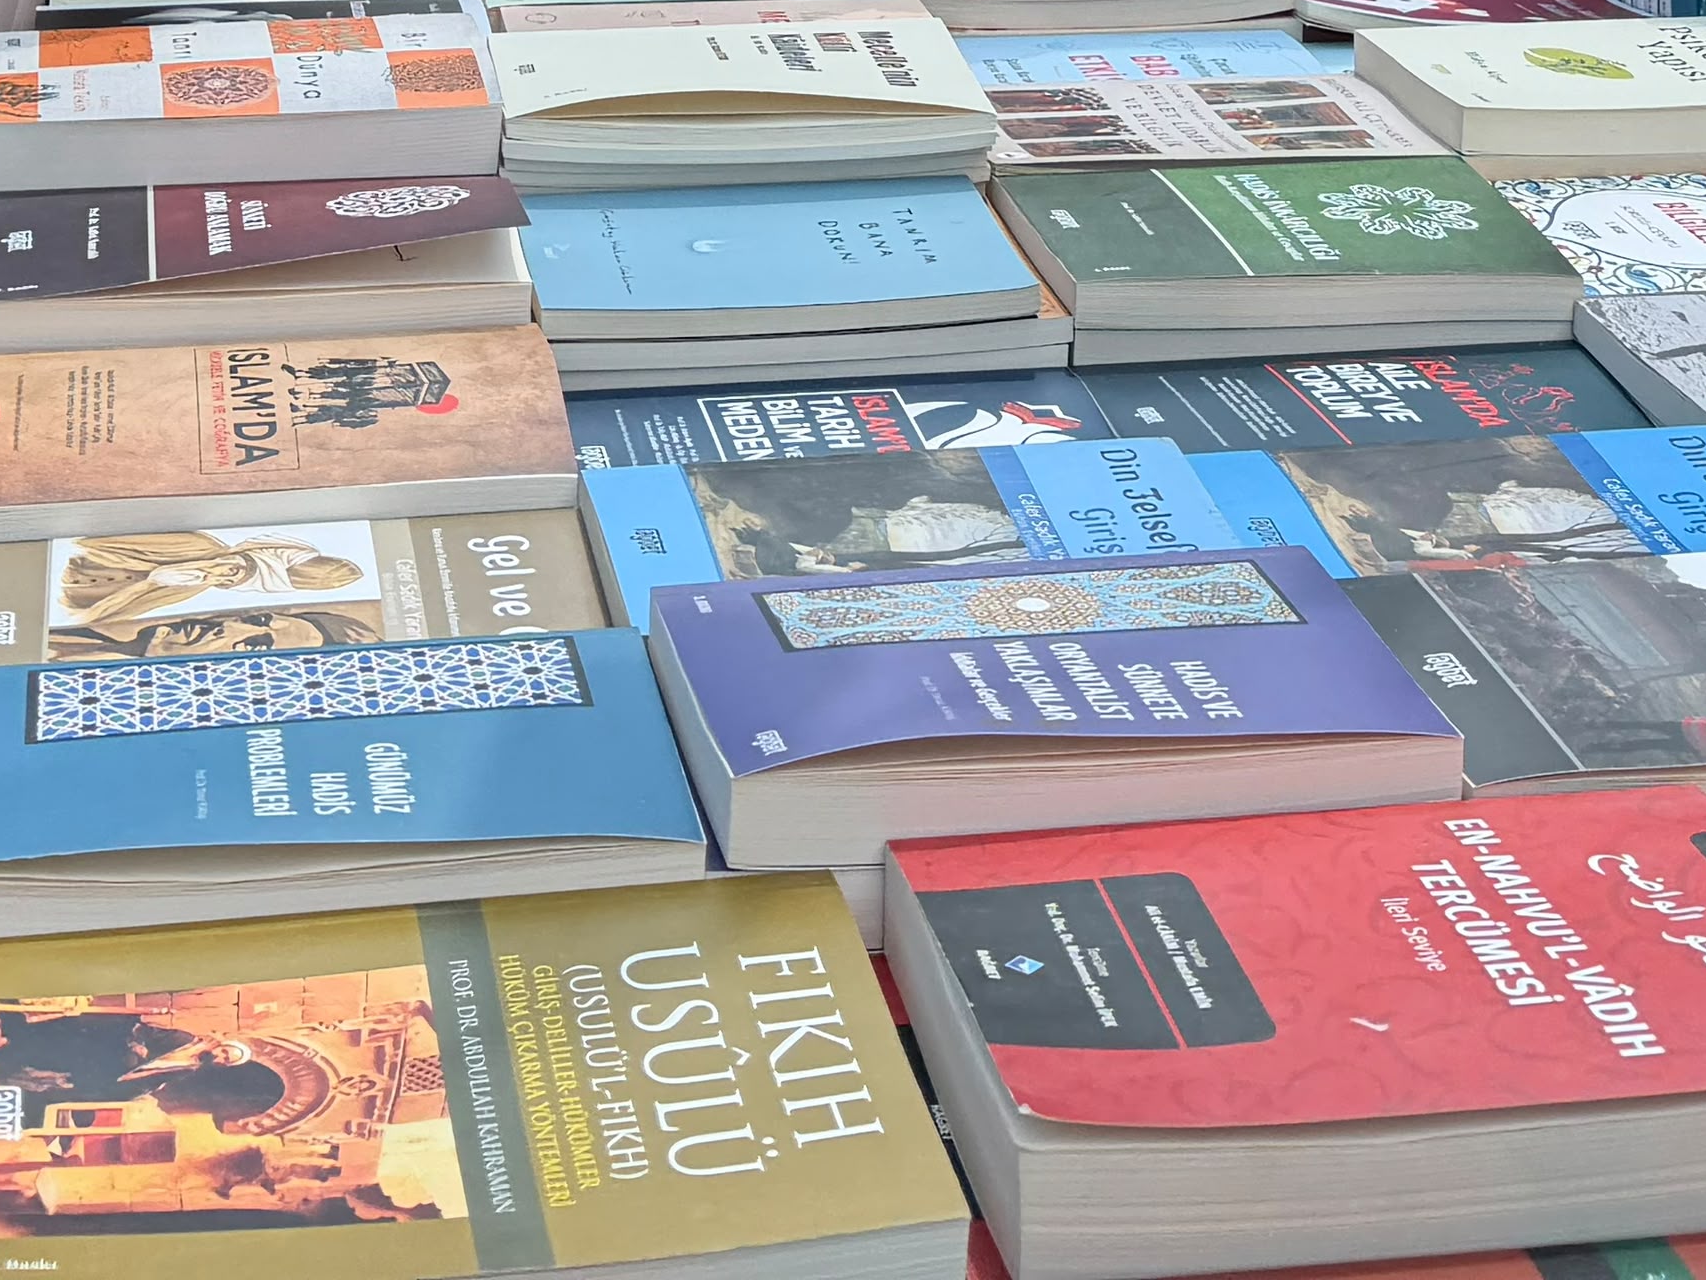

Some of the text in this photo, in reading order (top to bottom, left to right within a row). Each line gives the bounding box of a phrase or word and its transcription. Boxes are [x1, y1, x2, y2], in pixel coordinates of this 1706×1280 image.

[400, 30, 430, 50] Bir
[309, 55, 321, 100] Dünya
[1233, 173, 1280, 200] HADİS
[817, 220, 860, 266] DOKUN!
[857, 222, 896, 258] BANA
[892, 207, 938, 265] TANRIM
[1285, 365, 1373, 419] TOPLUM
[1326, 363, 1400, 400] BİREY
[1366, 362, 1433, 391] AİLE
[761, 399, 816, 444] BİLİM
[806, 395, 866, 449] TARİH
[1099, 446, 1142, 488] Din
[467, 534, 536, 618] Gel ve
[991, 640, 1077, 721] YAKLAŞIMLAR
[1047, 642, 1135, 721] ORYANTALİST
[1116, 663, 1190, 720] SÜNNETE
[1169, 660, 1230, 699] HADİS
[246, 728, 298, 817] PROBLEMLERİ
[310, 771, 356, 816] HADİS
[364, 742, 416, 815] GÜNÜMÜZ
[1380, 896, 1447, 973] İleri Seviye
[1410, 859, 1566, 1007] TERCÜMESİ
[618, 940, 767, 1176] USÛLÜ
[737, 945, 885, 1151] FIKIH
[447, 958, 517, 1214] PROF. ABDULLAH KAHRAMAN
[497, 953, 577, 1209] HÜKÜM ÇIKARMA YÖNTEMLERİ
[531, 964, 601, 1190] GİRİŞ-DELİLLER-HÜKÜMLER
